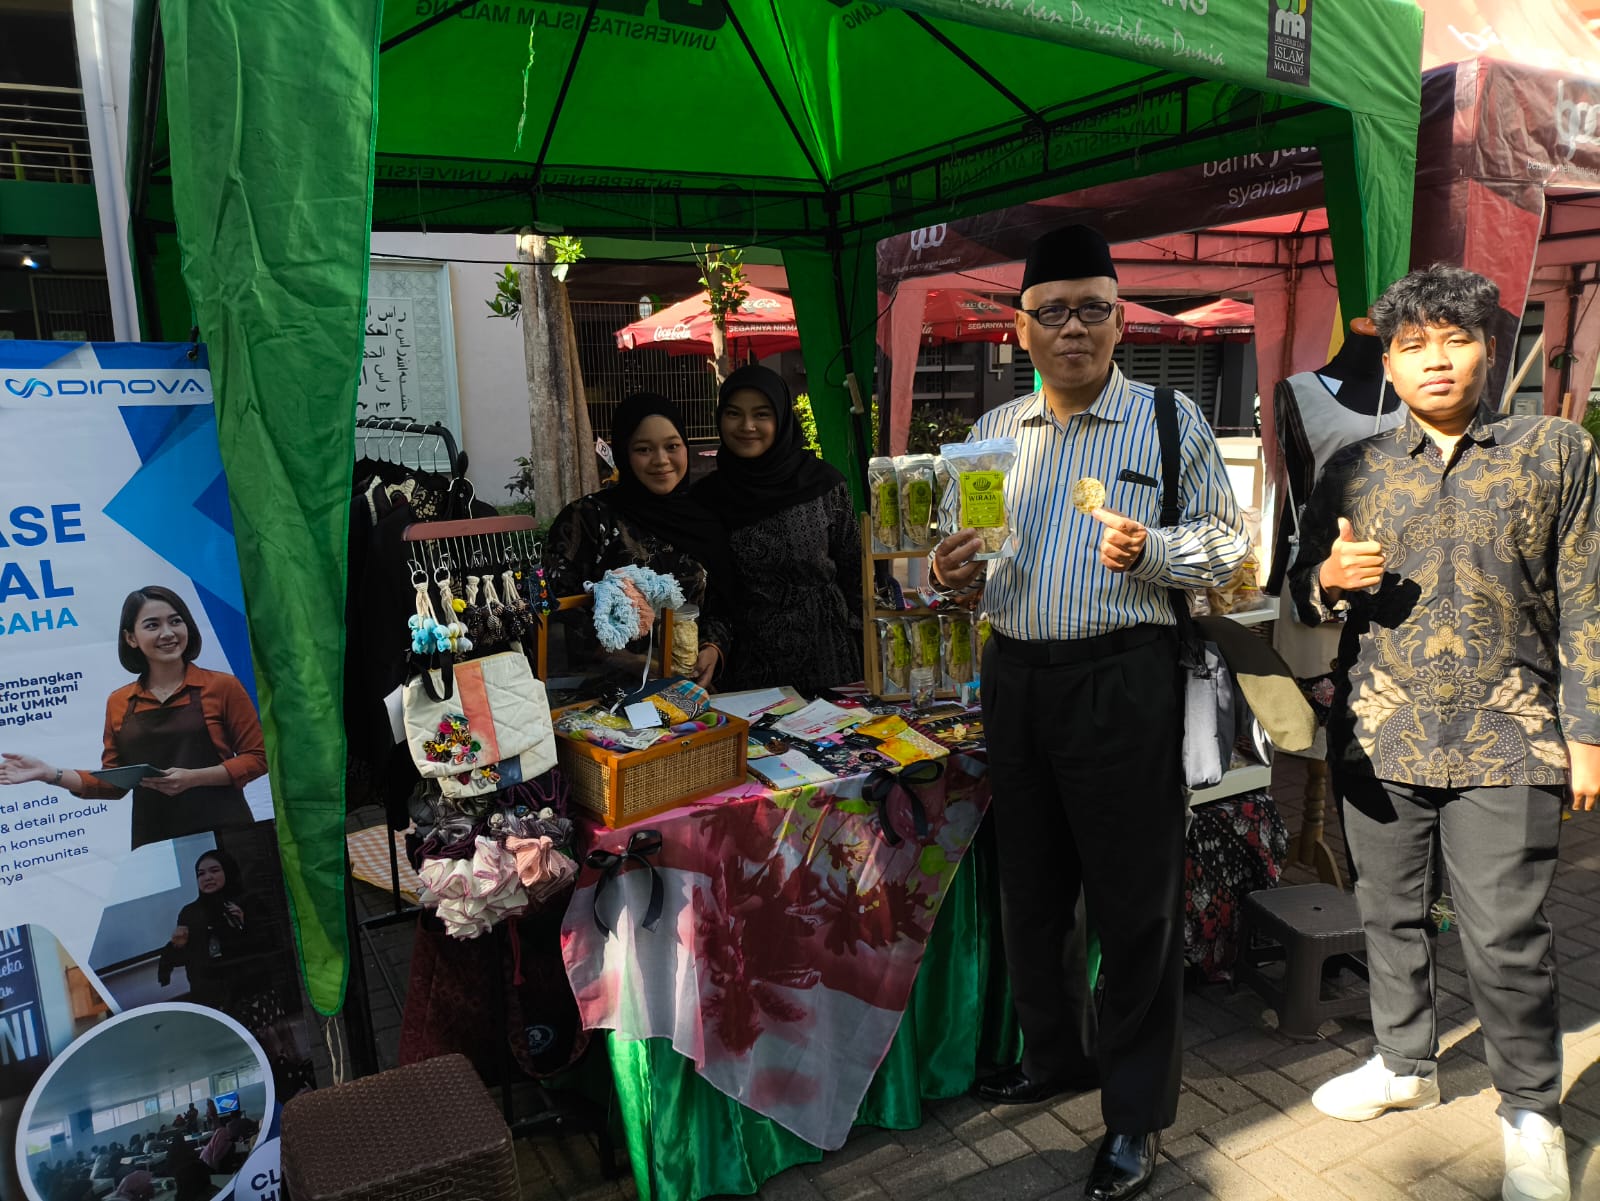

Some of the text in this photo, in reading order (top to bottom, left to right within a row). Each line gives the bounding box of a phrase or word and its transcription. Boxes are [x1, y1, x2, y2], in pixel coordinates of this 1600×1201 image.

[1275, 46, 1304, 64] ISLAM
[1274, 61, 1304, 76] MALANG
[1228, 171, 1302, 208] syariah
[653, 324, 693, 341] Coca-Cola
[967, 322, 1003, 330] SEGARNYA
[43, 680, 78, 696] kami
[21, 694, 67, 711] UMKM
[23, 795, 58, 810] anda
[0, 803, 108, 834] & detail produk
[10, 828, 85, 850] konsumen
[13, 846, 89, 870] komunitas
